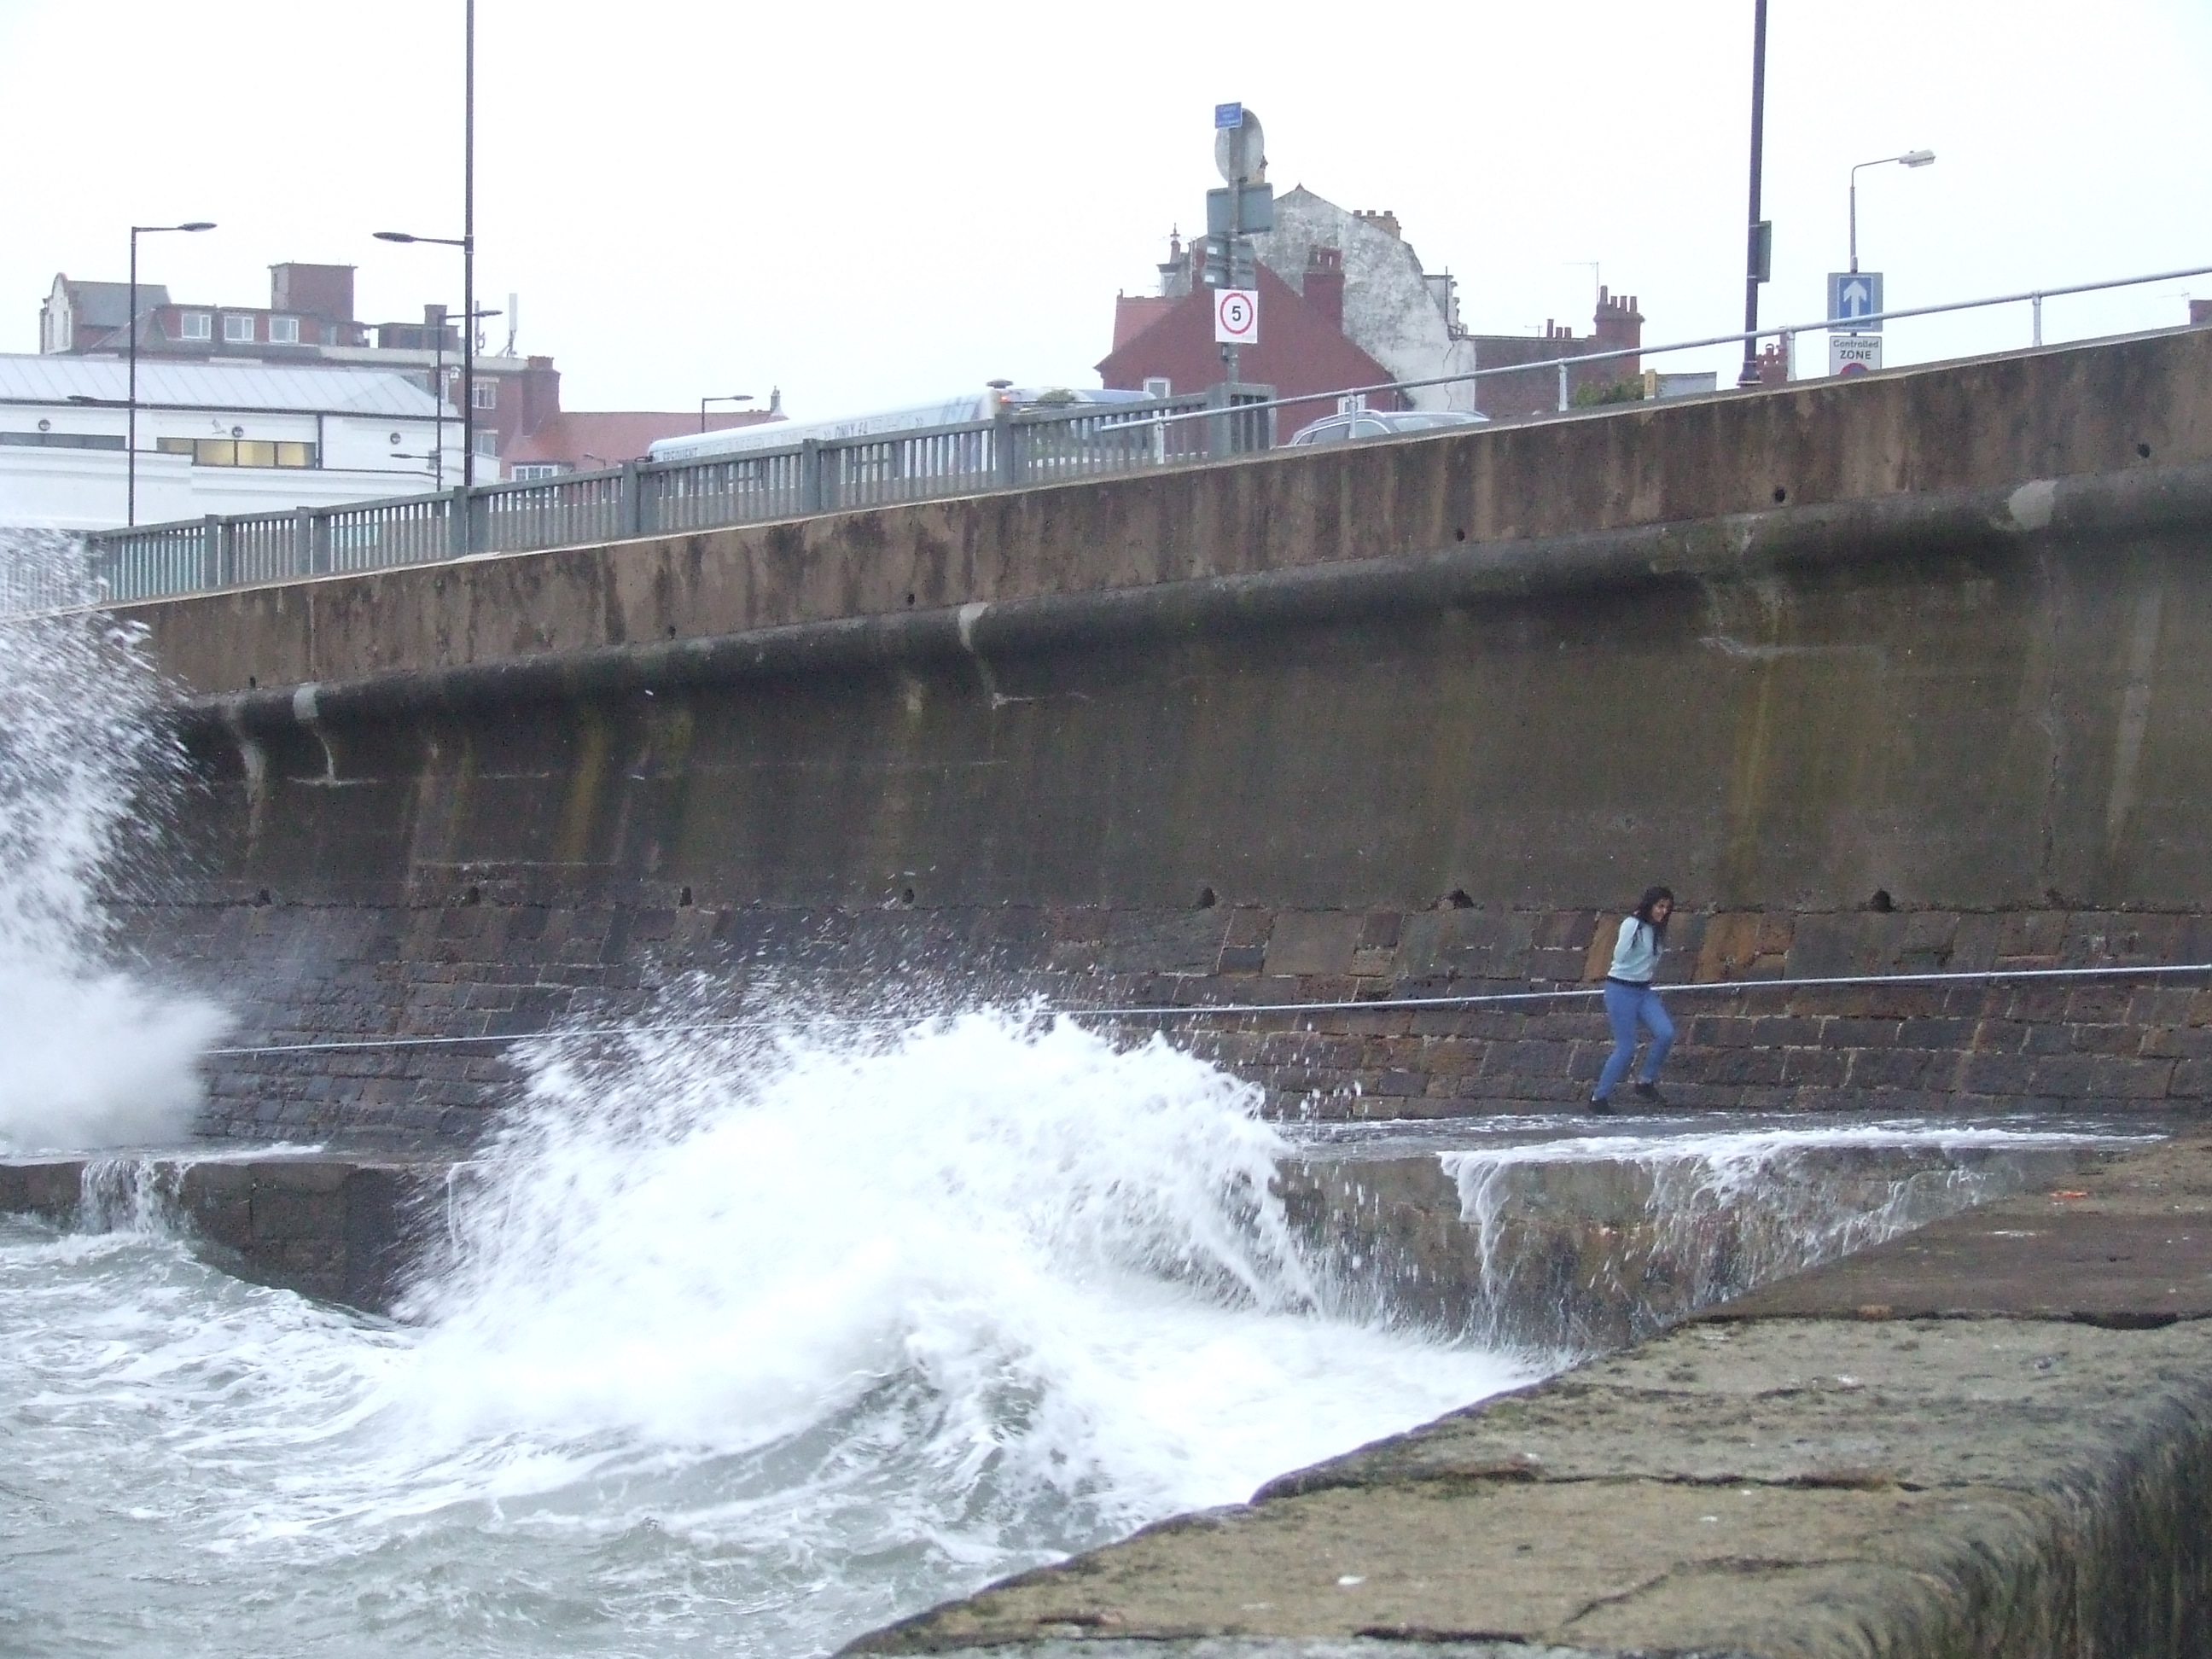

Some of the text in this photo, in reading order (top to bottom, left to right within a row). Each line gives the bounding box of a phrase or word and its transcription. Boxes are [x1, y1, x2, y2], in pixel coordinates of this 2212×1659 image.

[1231, 306, 1242, 322] 5
[1833, 340, 1879, 348] Controlled
[1840, 350, 1871, 359] ZONE
